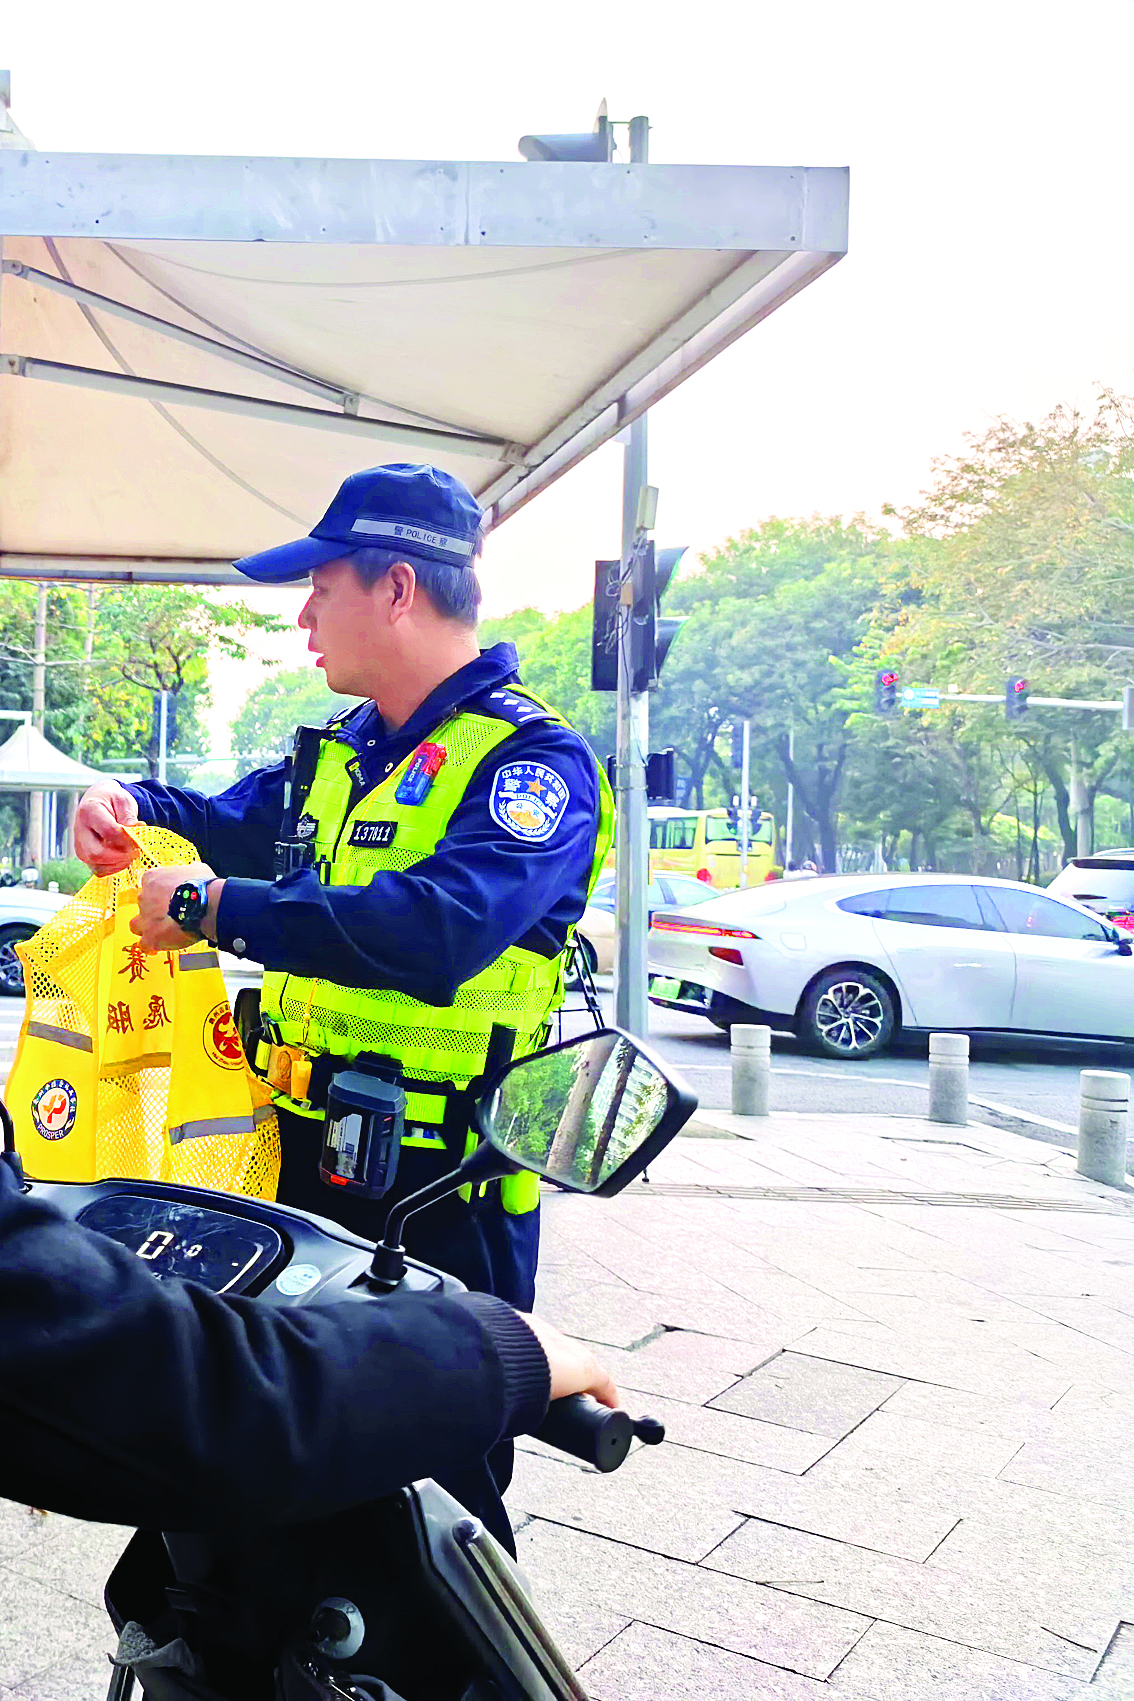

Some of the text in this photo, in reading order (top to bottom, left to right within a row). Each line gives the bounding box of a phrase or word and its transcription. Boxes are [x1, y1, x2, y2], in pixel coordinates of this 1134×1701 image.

[406, 529, 437, 543] POLICE
[407, 758, 423, 782] POLICE
[501, 766, 566, 801] 中华人民共和国
[37, 1124, 65, 1140] PROSPER
[135, 1230, 175, 1260] 0
